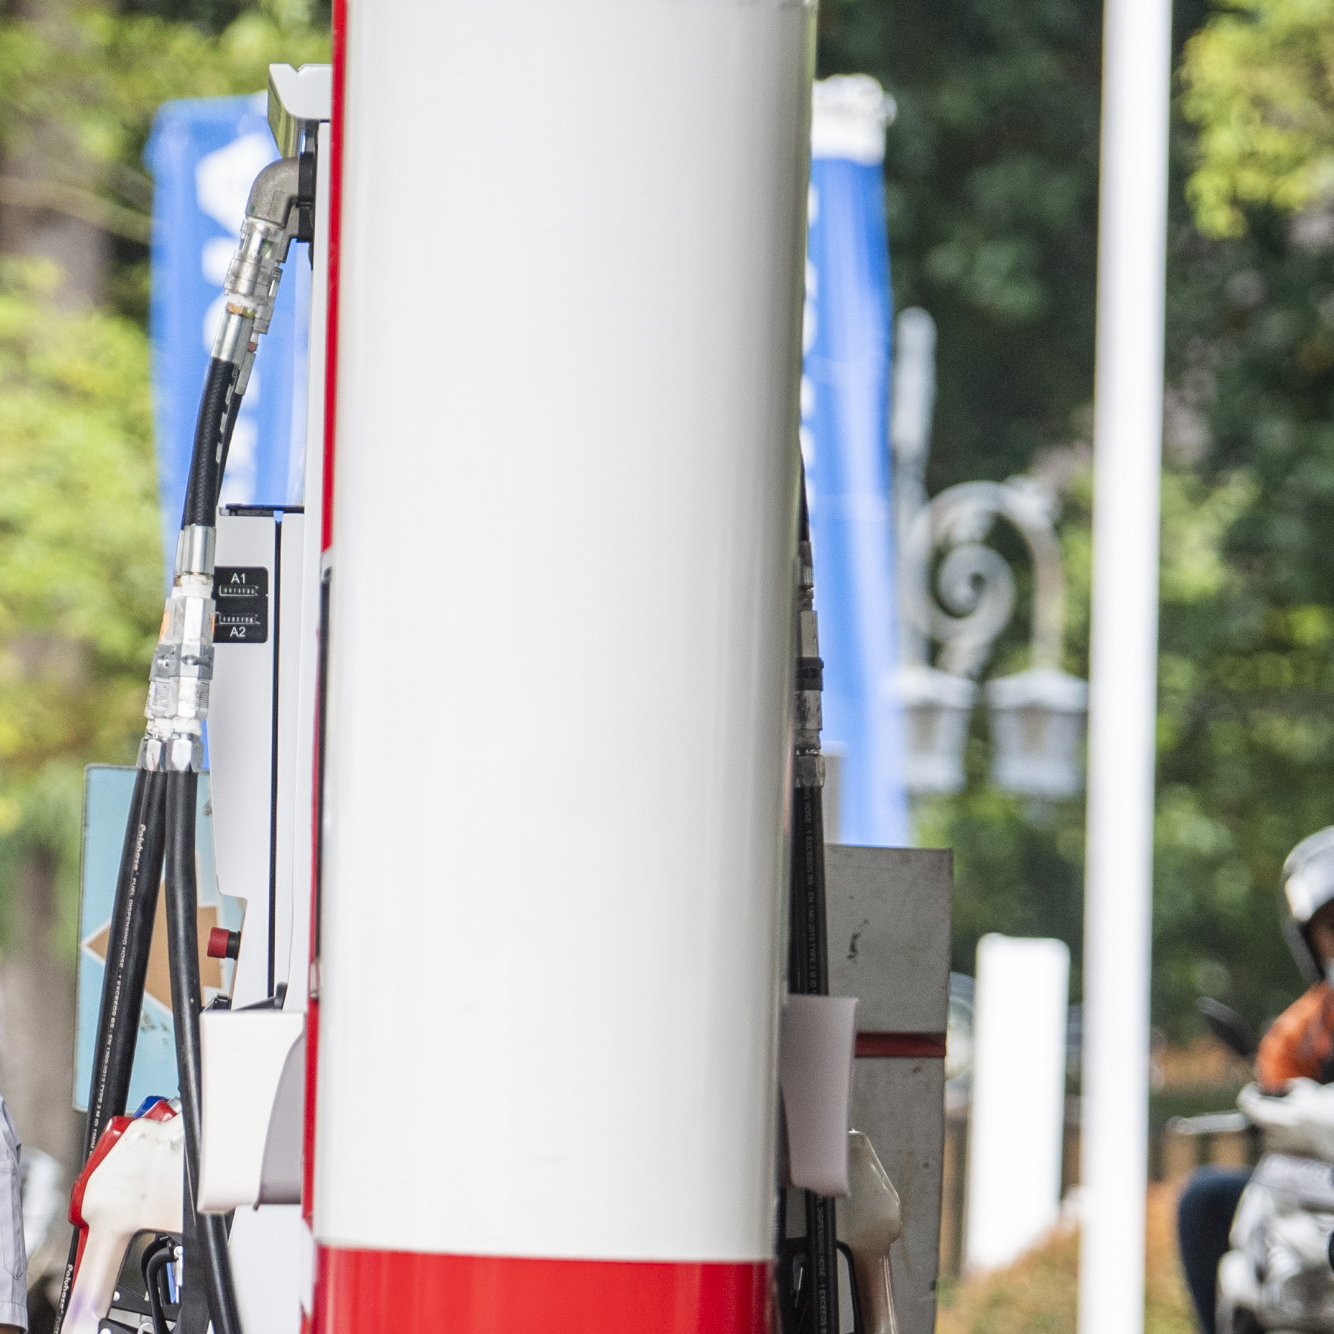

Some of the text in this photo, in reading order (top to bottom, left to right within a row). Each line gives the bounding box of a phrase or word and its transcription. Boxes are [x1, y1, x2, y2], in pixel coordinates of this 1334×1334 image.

[230, 572, 247, 584] A1
[229, 626, 247, 638] A2
[133, 824, 146, 870] Polyhose
[123, 900, 133, 944] DISPENSING
[112, 980, 121, 1015] EXCEEDS
[110, 1017, 116, 1028] BS
[107, 1034, 113, 1044] EN
[58, 1264, 73, 1310] Polyhose
